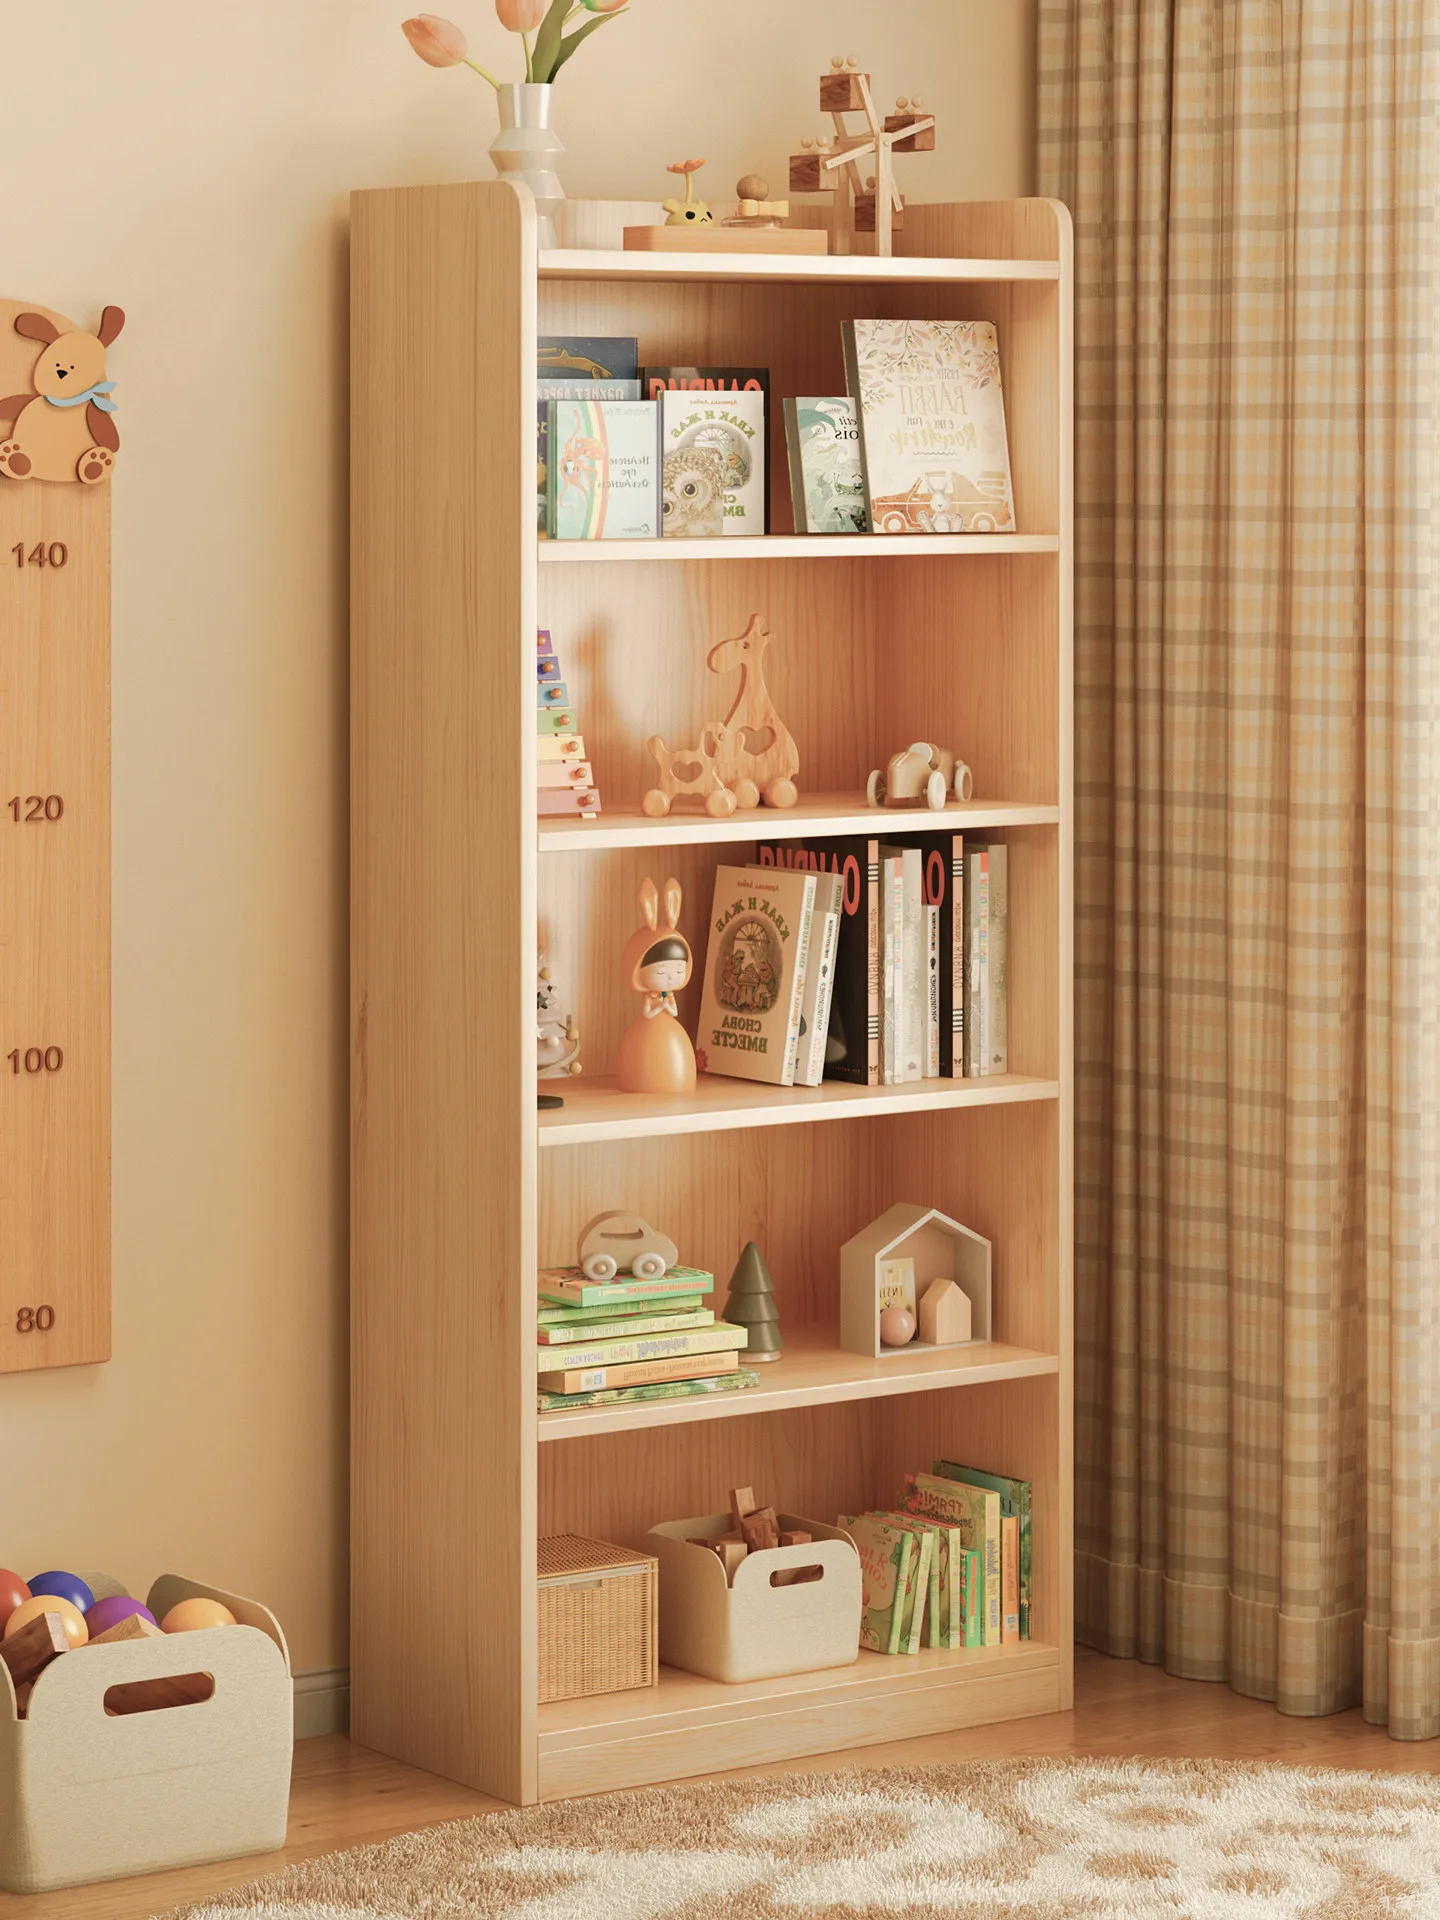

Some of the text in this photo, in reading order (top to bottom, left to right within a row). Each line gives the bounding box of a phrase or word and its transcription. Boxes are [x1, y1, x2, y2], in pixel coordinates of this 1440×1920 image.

[12, 542, 67, 568] 140
[8, 795, 63, 822] 120
[8, 1046, 63, 1074] 100
[17, 1305, 54, 1333] 80
